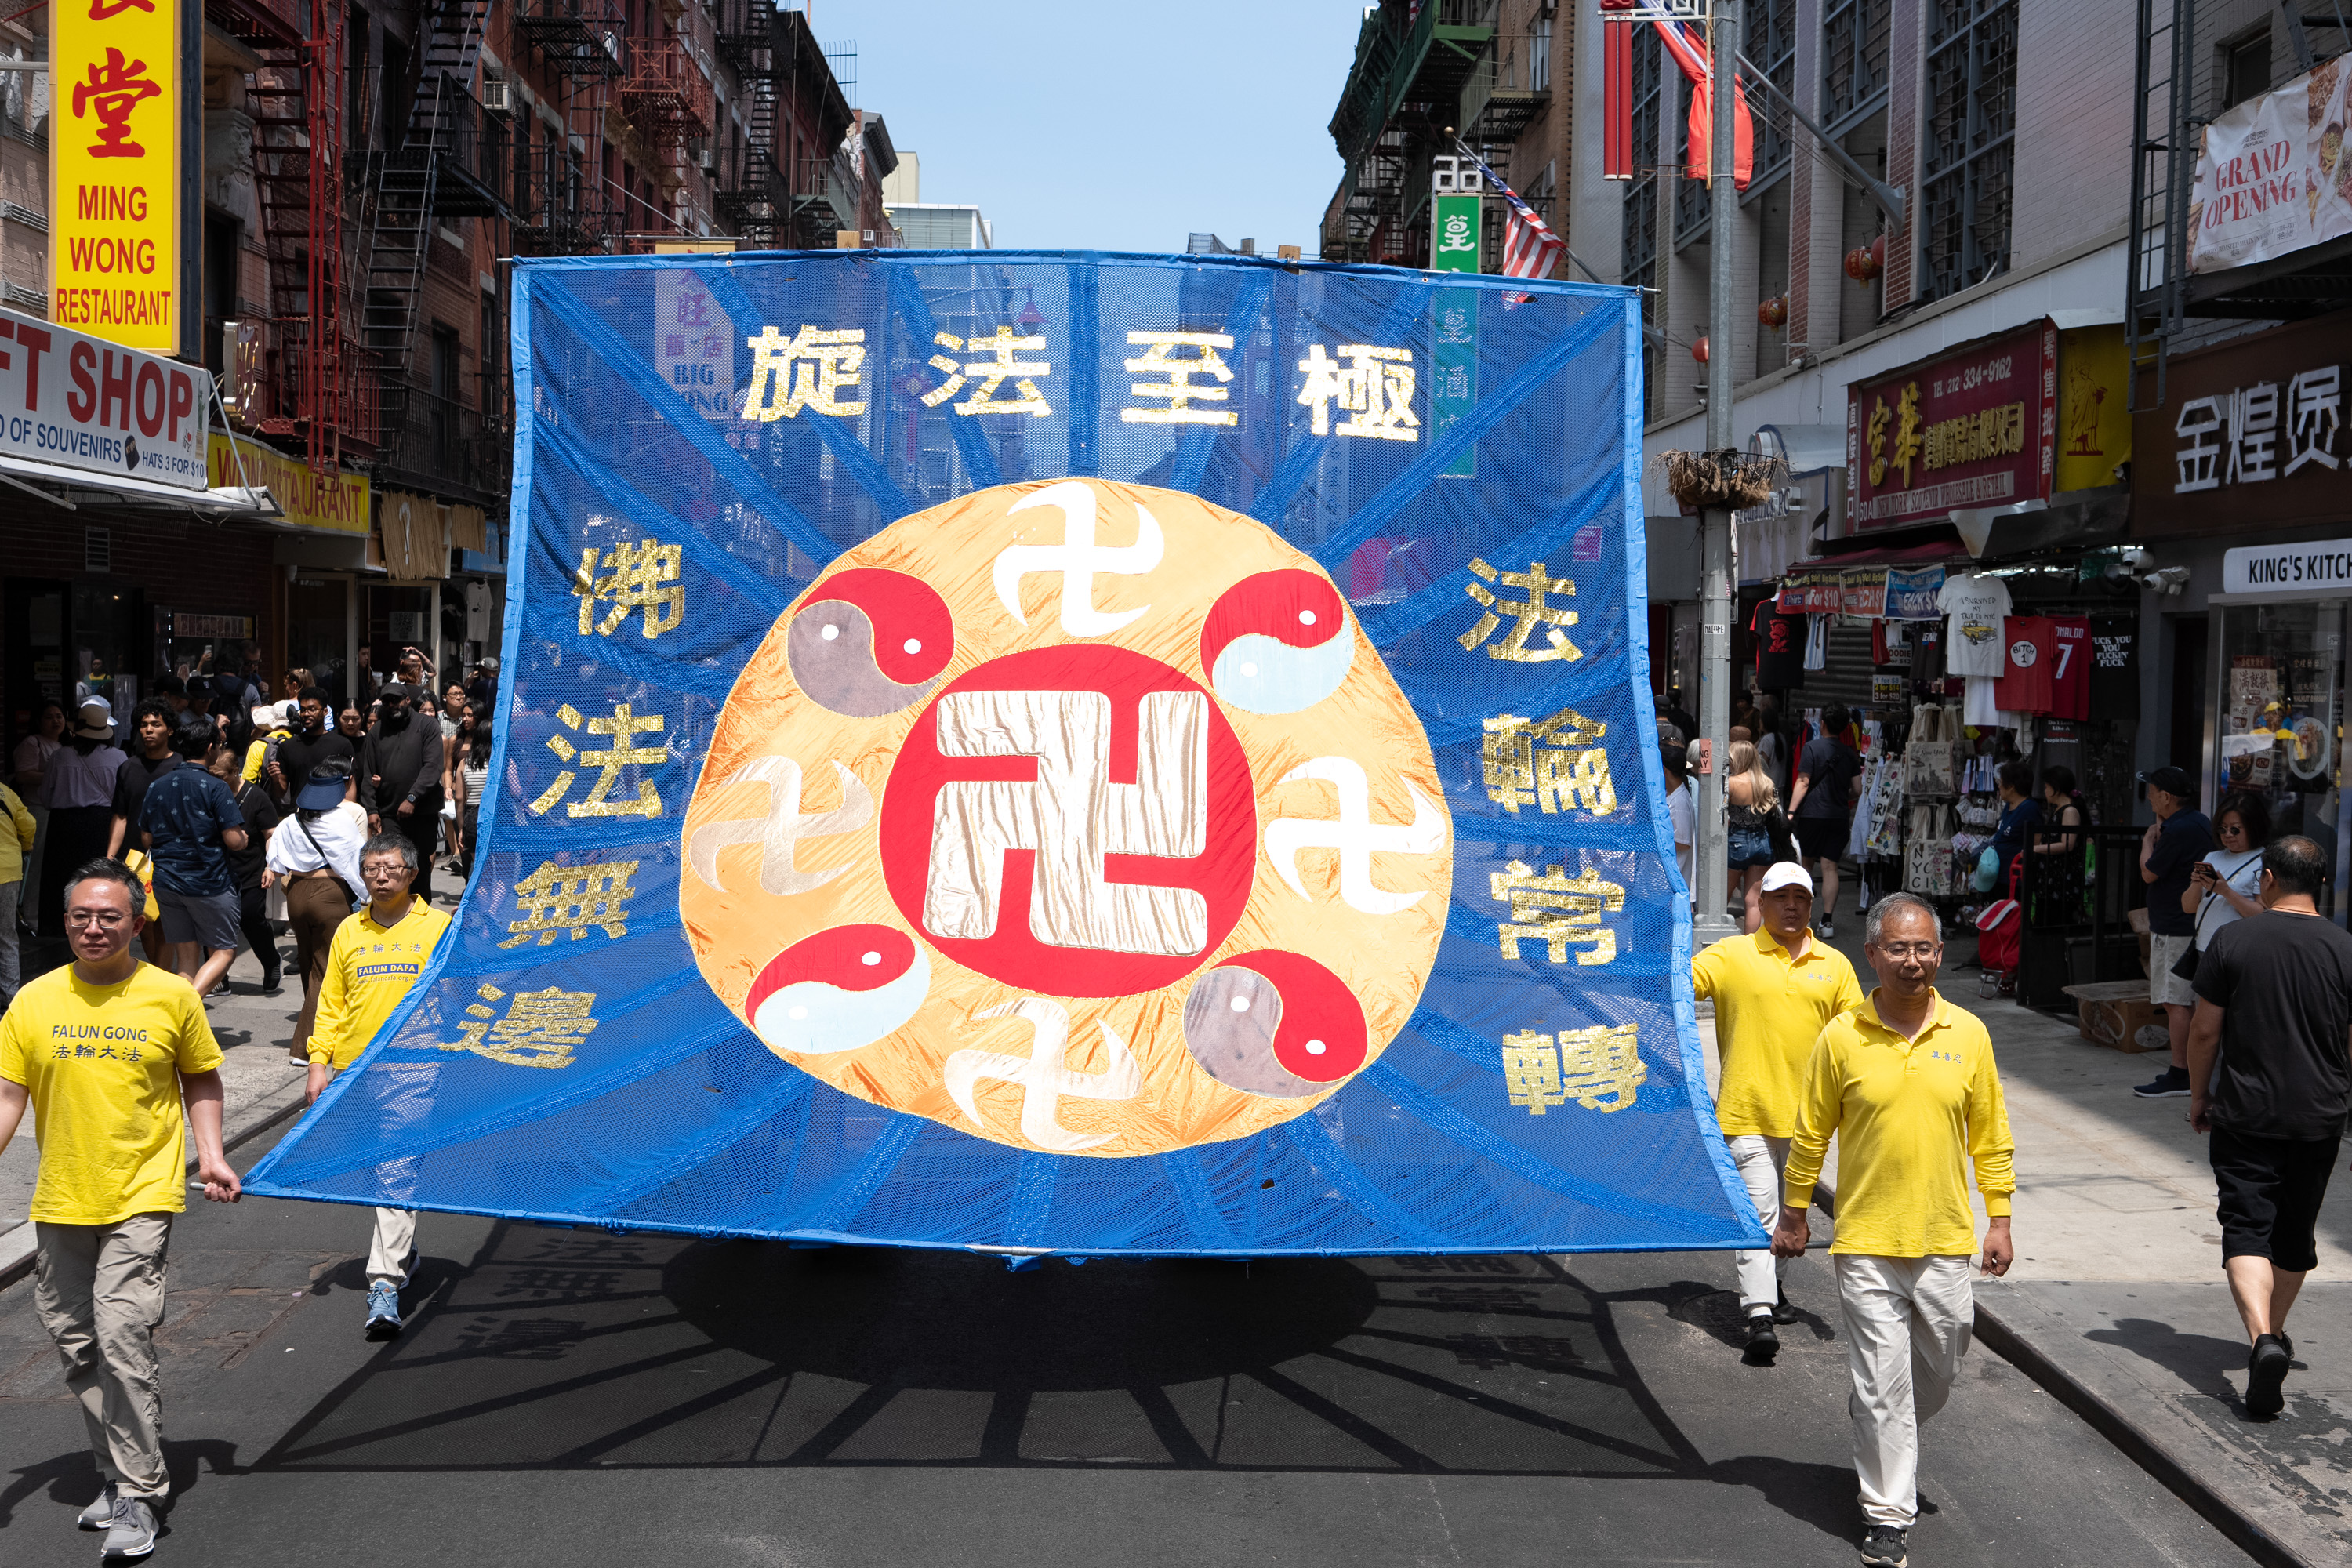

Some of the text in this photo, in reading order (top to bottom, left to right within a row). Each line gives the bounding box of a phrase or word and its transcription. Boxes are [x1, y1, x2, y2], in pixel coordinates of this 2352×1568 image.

[72, 0, 162, 158] 堂
[2216, 140, 2290, 192] GRAND
[78, 186, 147, 222] MING
[2205, 170, 2297, 230] OPENING
[70, 238, 155, 273] WONG
[57, 288, 171, 325] RESTAURANT
[674, 364, 714, 385] BIG
[741, 323, 1421, 442] 旋法至極
[1947, 376, 1960, 394] 212
[1963, 355, 2012, 390] 334-9162
[67, 340, 193, 443] SHOP
[679, 391, 729, 412] ONG
[2042, 329, 2055, 475] 零售批發
[10, 417, 32, 443] OF
[36, 423, 122, 463] SOUVENIRS
[2174, 365, 2352, 494] 金煌煲
[142, 451, 204, 478] HATS 3 FOR $10
[1847, 401, 1857, 519] 直接進口
[1859, 500, 1873, 521] 60A
[1878, 497, 1889, 517] NEW
[1891, 493, 1907, 515] YORK
[1911, 488, 1938, 511] SOUVENIR
[1940, 480, 1974, 506] WHOLESALE
[1983, 474, 2006, 498] RETAIL
[2249, 555, 2303, 583] KING'S
[1824, 590, 1838, 608] $10
[1904, 593, 1926, 612] EACH
[2056, 626, 2084, 639] ONALDO
[2114, 635, 2132, 644] YOU
[1889, 649, 1911, 658] OODIE
[2013, 644, 2035, 655] BITCH
[2021, 654, 2027, 662] 1
[2055, 643, 2074, 679] 7
[2096, 652, 2129, 660] FUCKIN'
[2100, 659, 2125, 667] FUCK
[437, 538, 685, 1069] 佛法無邊
[1457, 557, 1649, 1116] 法輪常轉
[356, 942, 421, 956] 法輪大法
[358, 965, 387, 975] FALUN
[52, 1025, 147, 1042] FALUN GONG
[52, 1044, 143, 1062] 法輪大法
